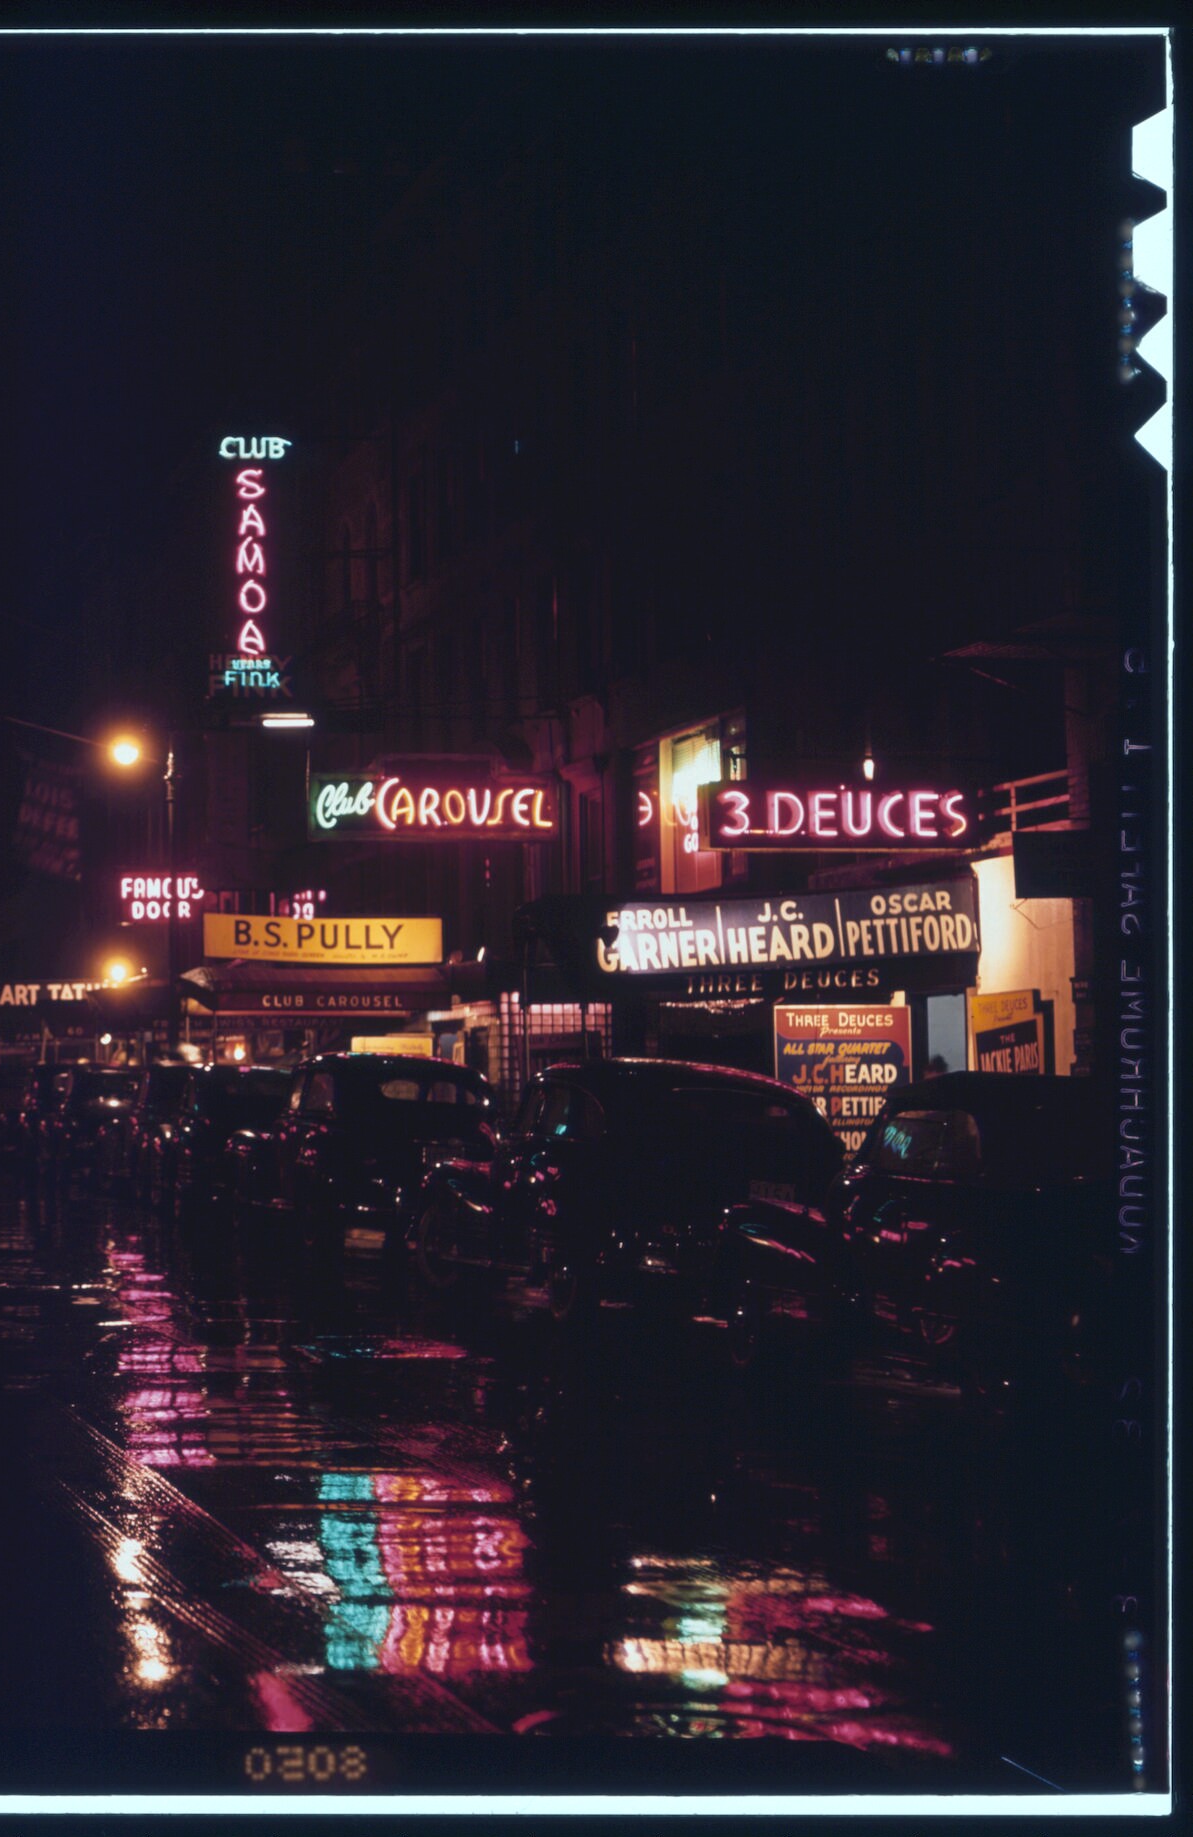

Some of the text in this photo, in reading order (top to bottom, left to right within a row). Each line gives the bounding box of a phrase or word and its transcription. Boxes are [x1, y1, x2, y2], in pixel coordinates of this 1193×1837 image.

[219, 436, 292, 460] CLUB
[235, 468, 268, 654] SAMOA
[316, 777, 553, 829] Club CAROUSEL
[773, 792, 968, 838] DEUCES
[870, 890, 953, 916] OSCAR
[606, 907, 694, 932] ERROLL
[297, 923, 404, 950] PULLY
[727, 922, 835, 965] HEARD
[846, 913, 972, 957] PETTIFORD
[597, 928, 719, 973] GARNER
[685, 968, 880, 994] THREE DEUCES
[261, 994, 403, 1009] CLUB CAROUSEL
[786, 1011, 894, 1028] THREE DEUCES
[819, 1026, 862, 1038] Presents
[783, 1042, 892, 1057] ALL STAR QUARTET
[999, 1033, 1016, 1045] THE
[830, 1063, 898, 1085] HEARD
[830, 1096, 885, 1117] PETTIF
